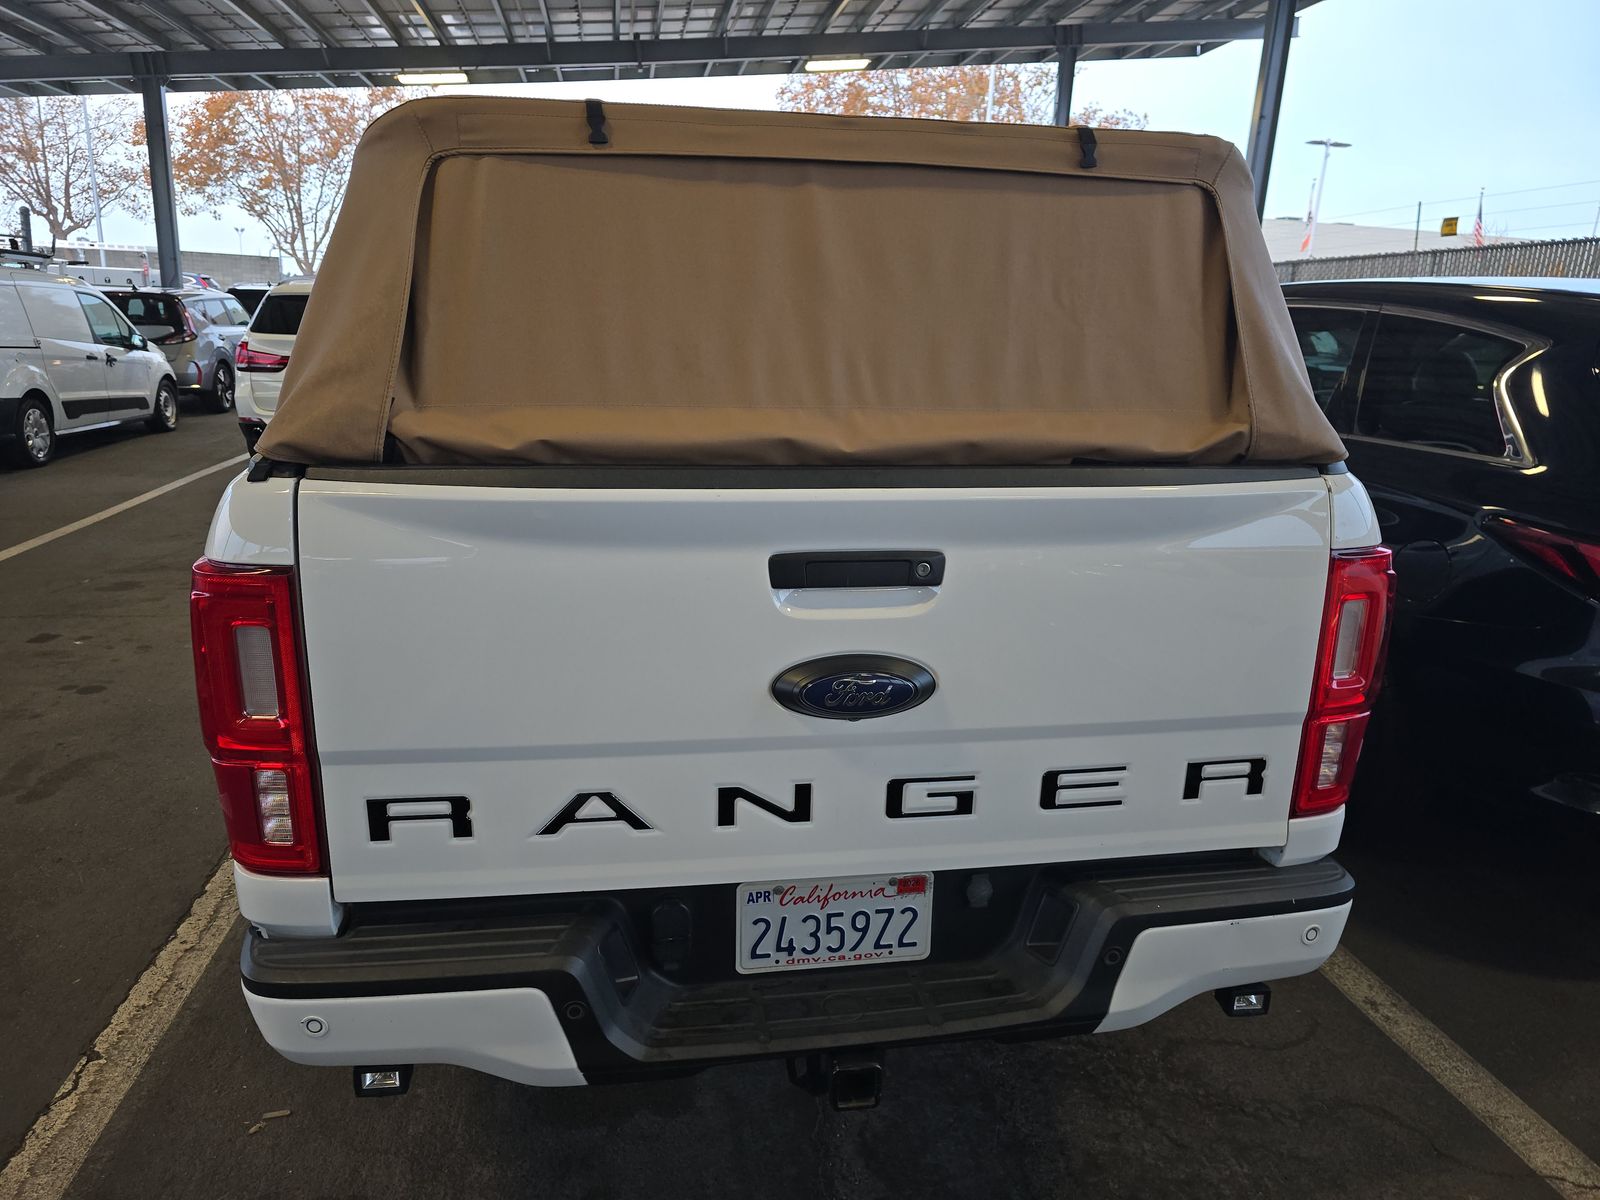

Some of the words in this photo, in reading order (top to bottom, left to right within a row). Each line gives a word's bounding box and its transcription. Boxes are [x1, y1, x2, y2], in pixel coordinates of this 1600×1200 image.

[824, 676, 893, 707] Ford
[366, 757, 1268, 842] RANGER
[746, 890, 772, 904] APR
[779, 883, 897, 910] California
[750, 906, 919, 960] 24359Z2
[786, 951, 884, 965] dmv.ca.gov
